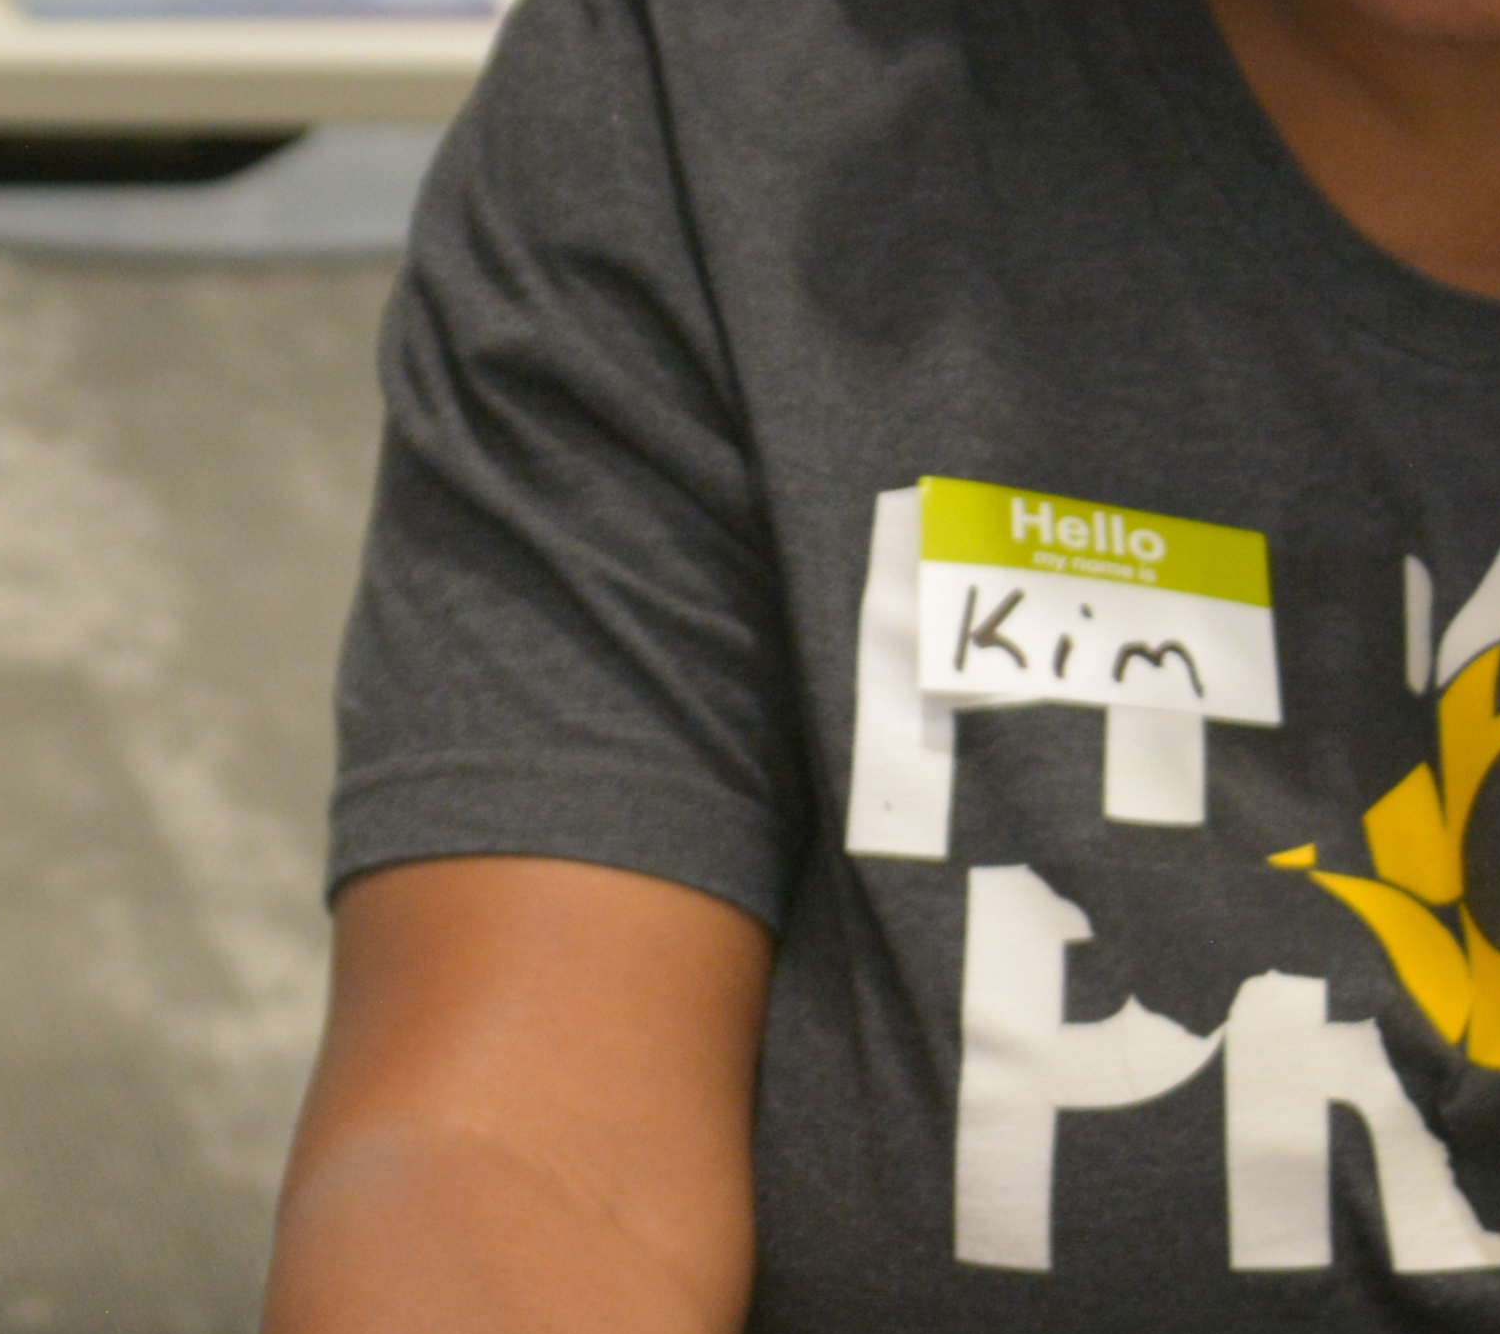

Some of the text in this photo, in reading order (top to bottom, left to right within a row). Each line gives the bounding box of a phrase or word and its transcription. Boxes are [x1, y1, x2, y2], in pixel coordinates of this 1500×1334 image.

[1011, 496, 1168, 562] Hello
[1032, 550, 1160, 584] my name is
[953, 584, 1205, 699] Kim
